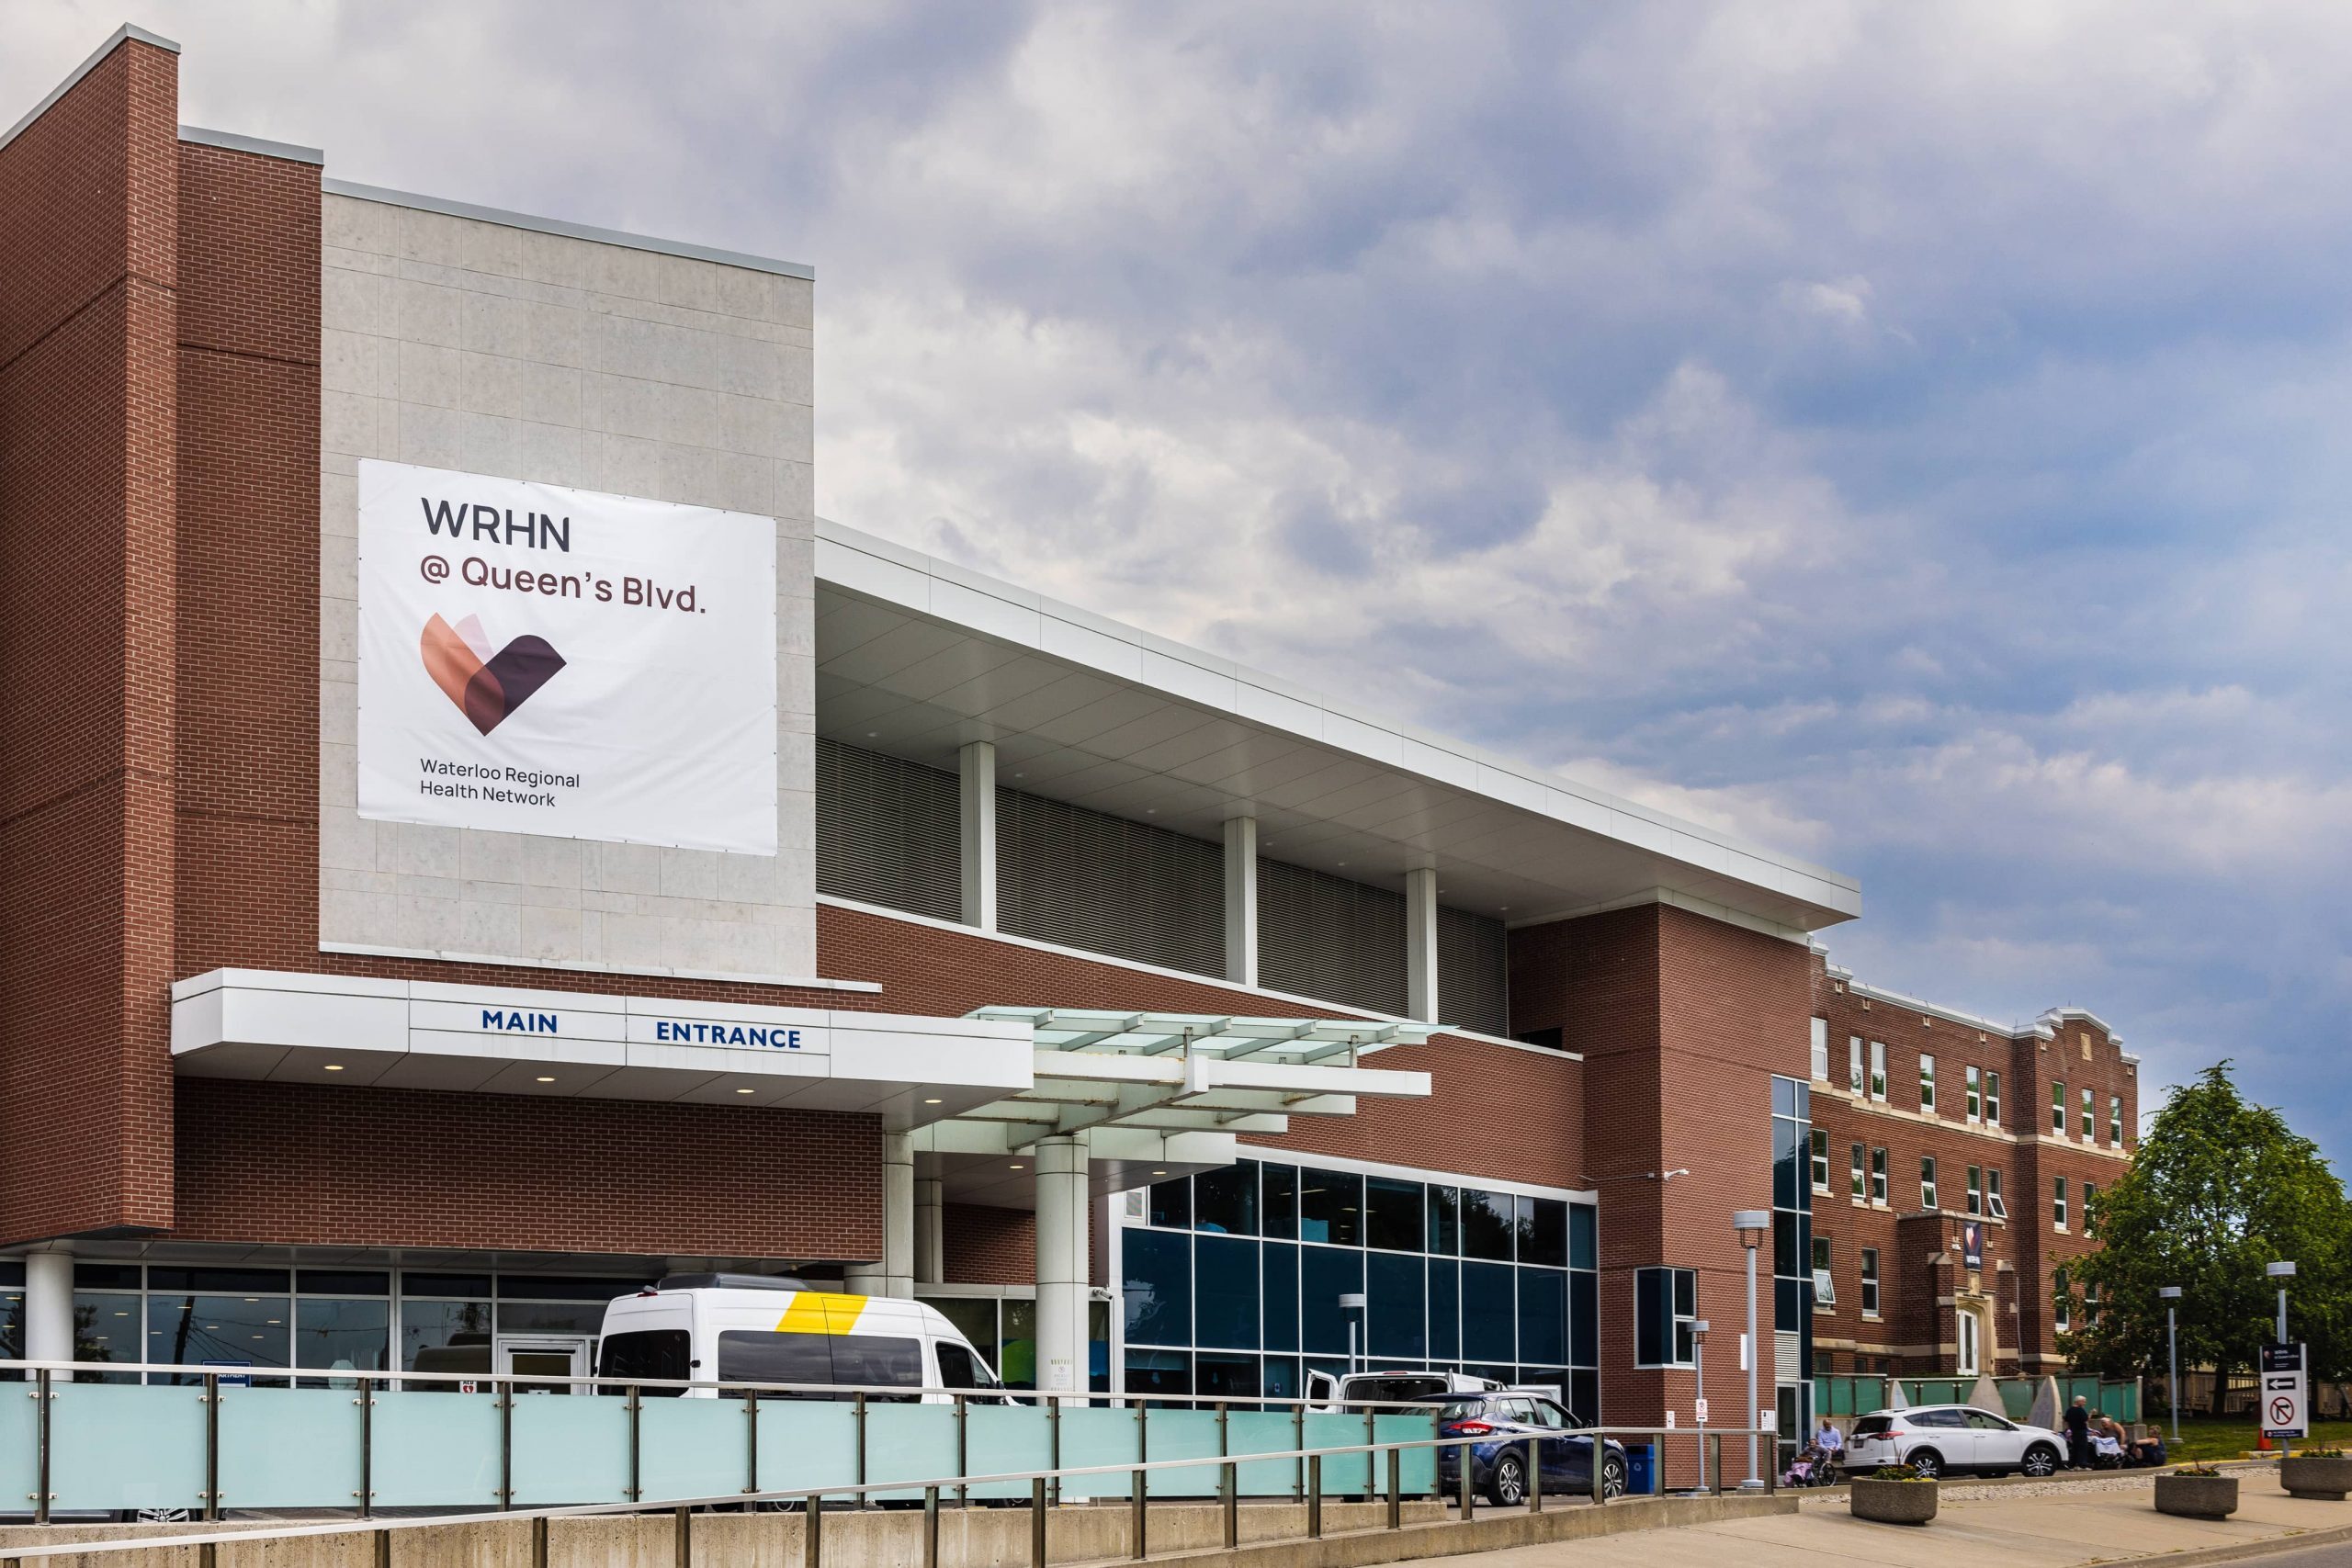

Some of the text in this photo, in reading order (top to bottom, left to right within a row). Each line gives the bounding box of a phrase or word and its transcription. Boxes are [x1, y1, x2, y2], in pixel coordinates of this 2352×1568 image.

[421, 497, 570, 553] WRHN
[421, 555, 707, 614] @ Queen's Blvd.
[421, 758, 580, 789] Waterloo Regional
[421, 780, 556, 807] Health Network
[482, 1010, 801, 1049] MAIN ENTRANCE
